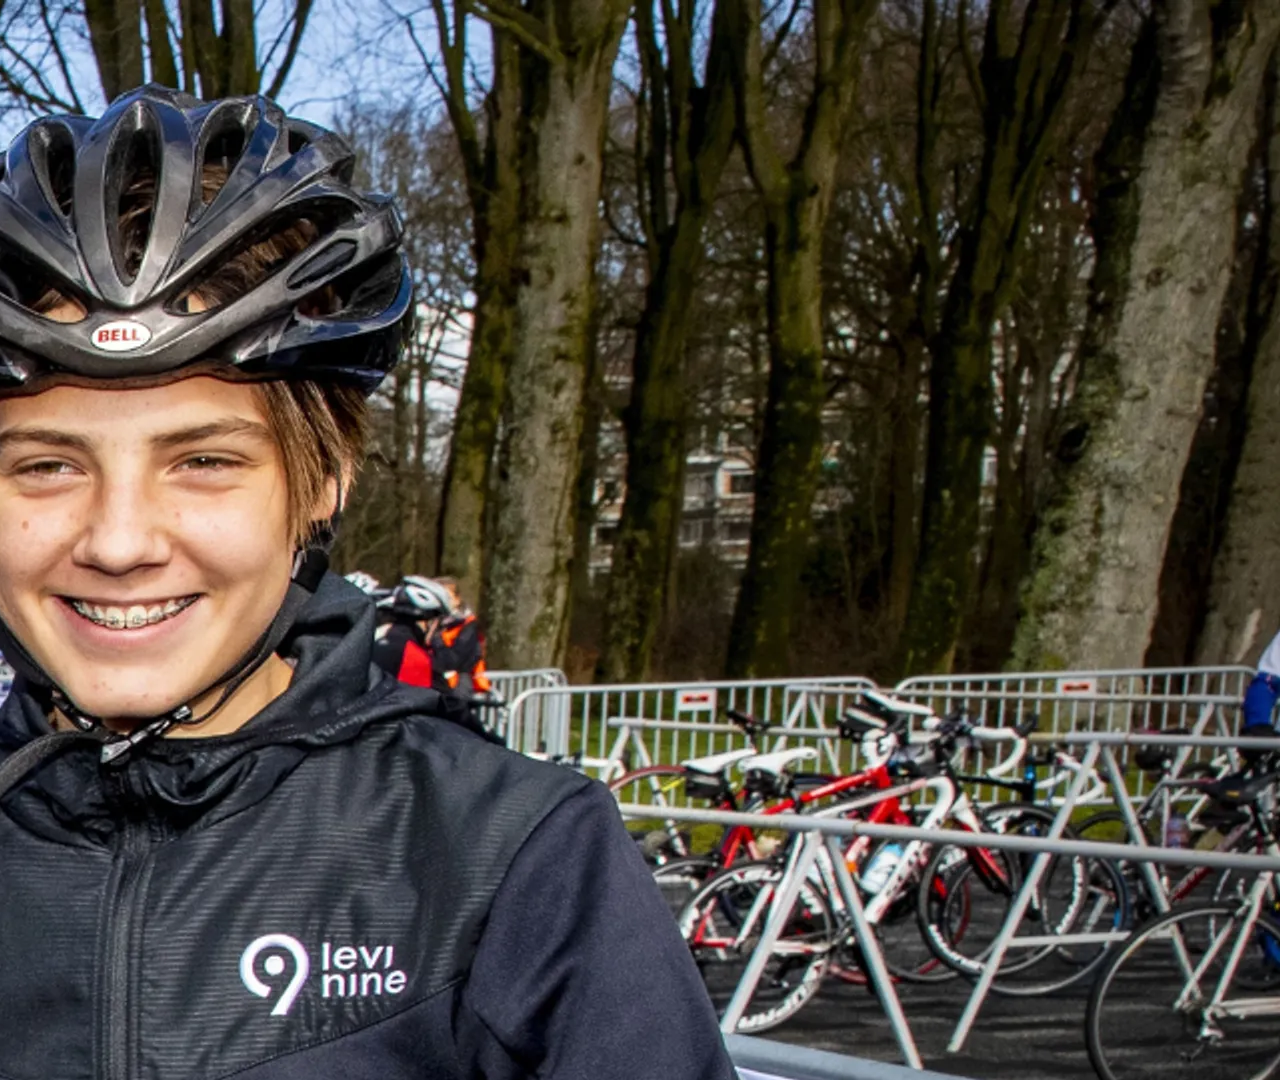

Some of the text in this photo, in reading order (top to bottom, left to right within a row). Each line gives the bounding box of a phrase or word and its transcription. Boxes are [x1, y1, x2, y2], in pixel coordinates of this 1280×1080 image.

[97, 328, 141, 343] BELL
[322, 942, 394, 971] levi
[322, 970, 407, 998] nine
